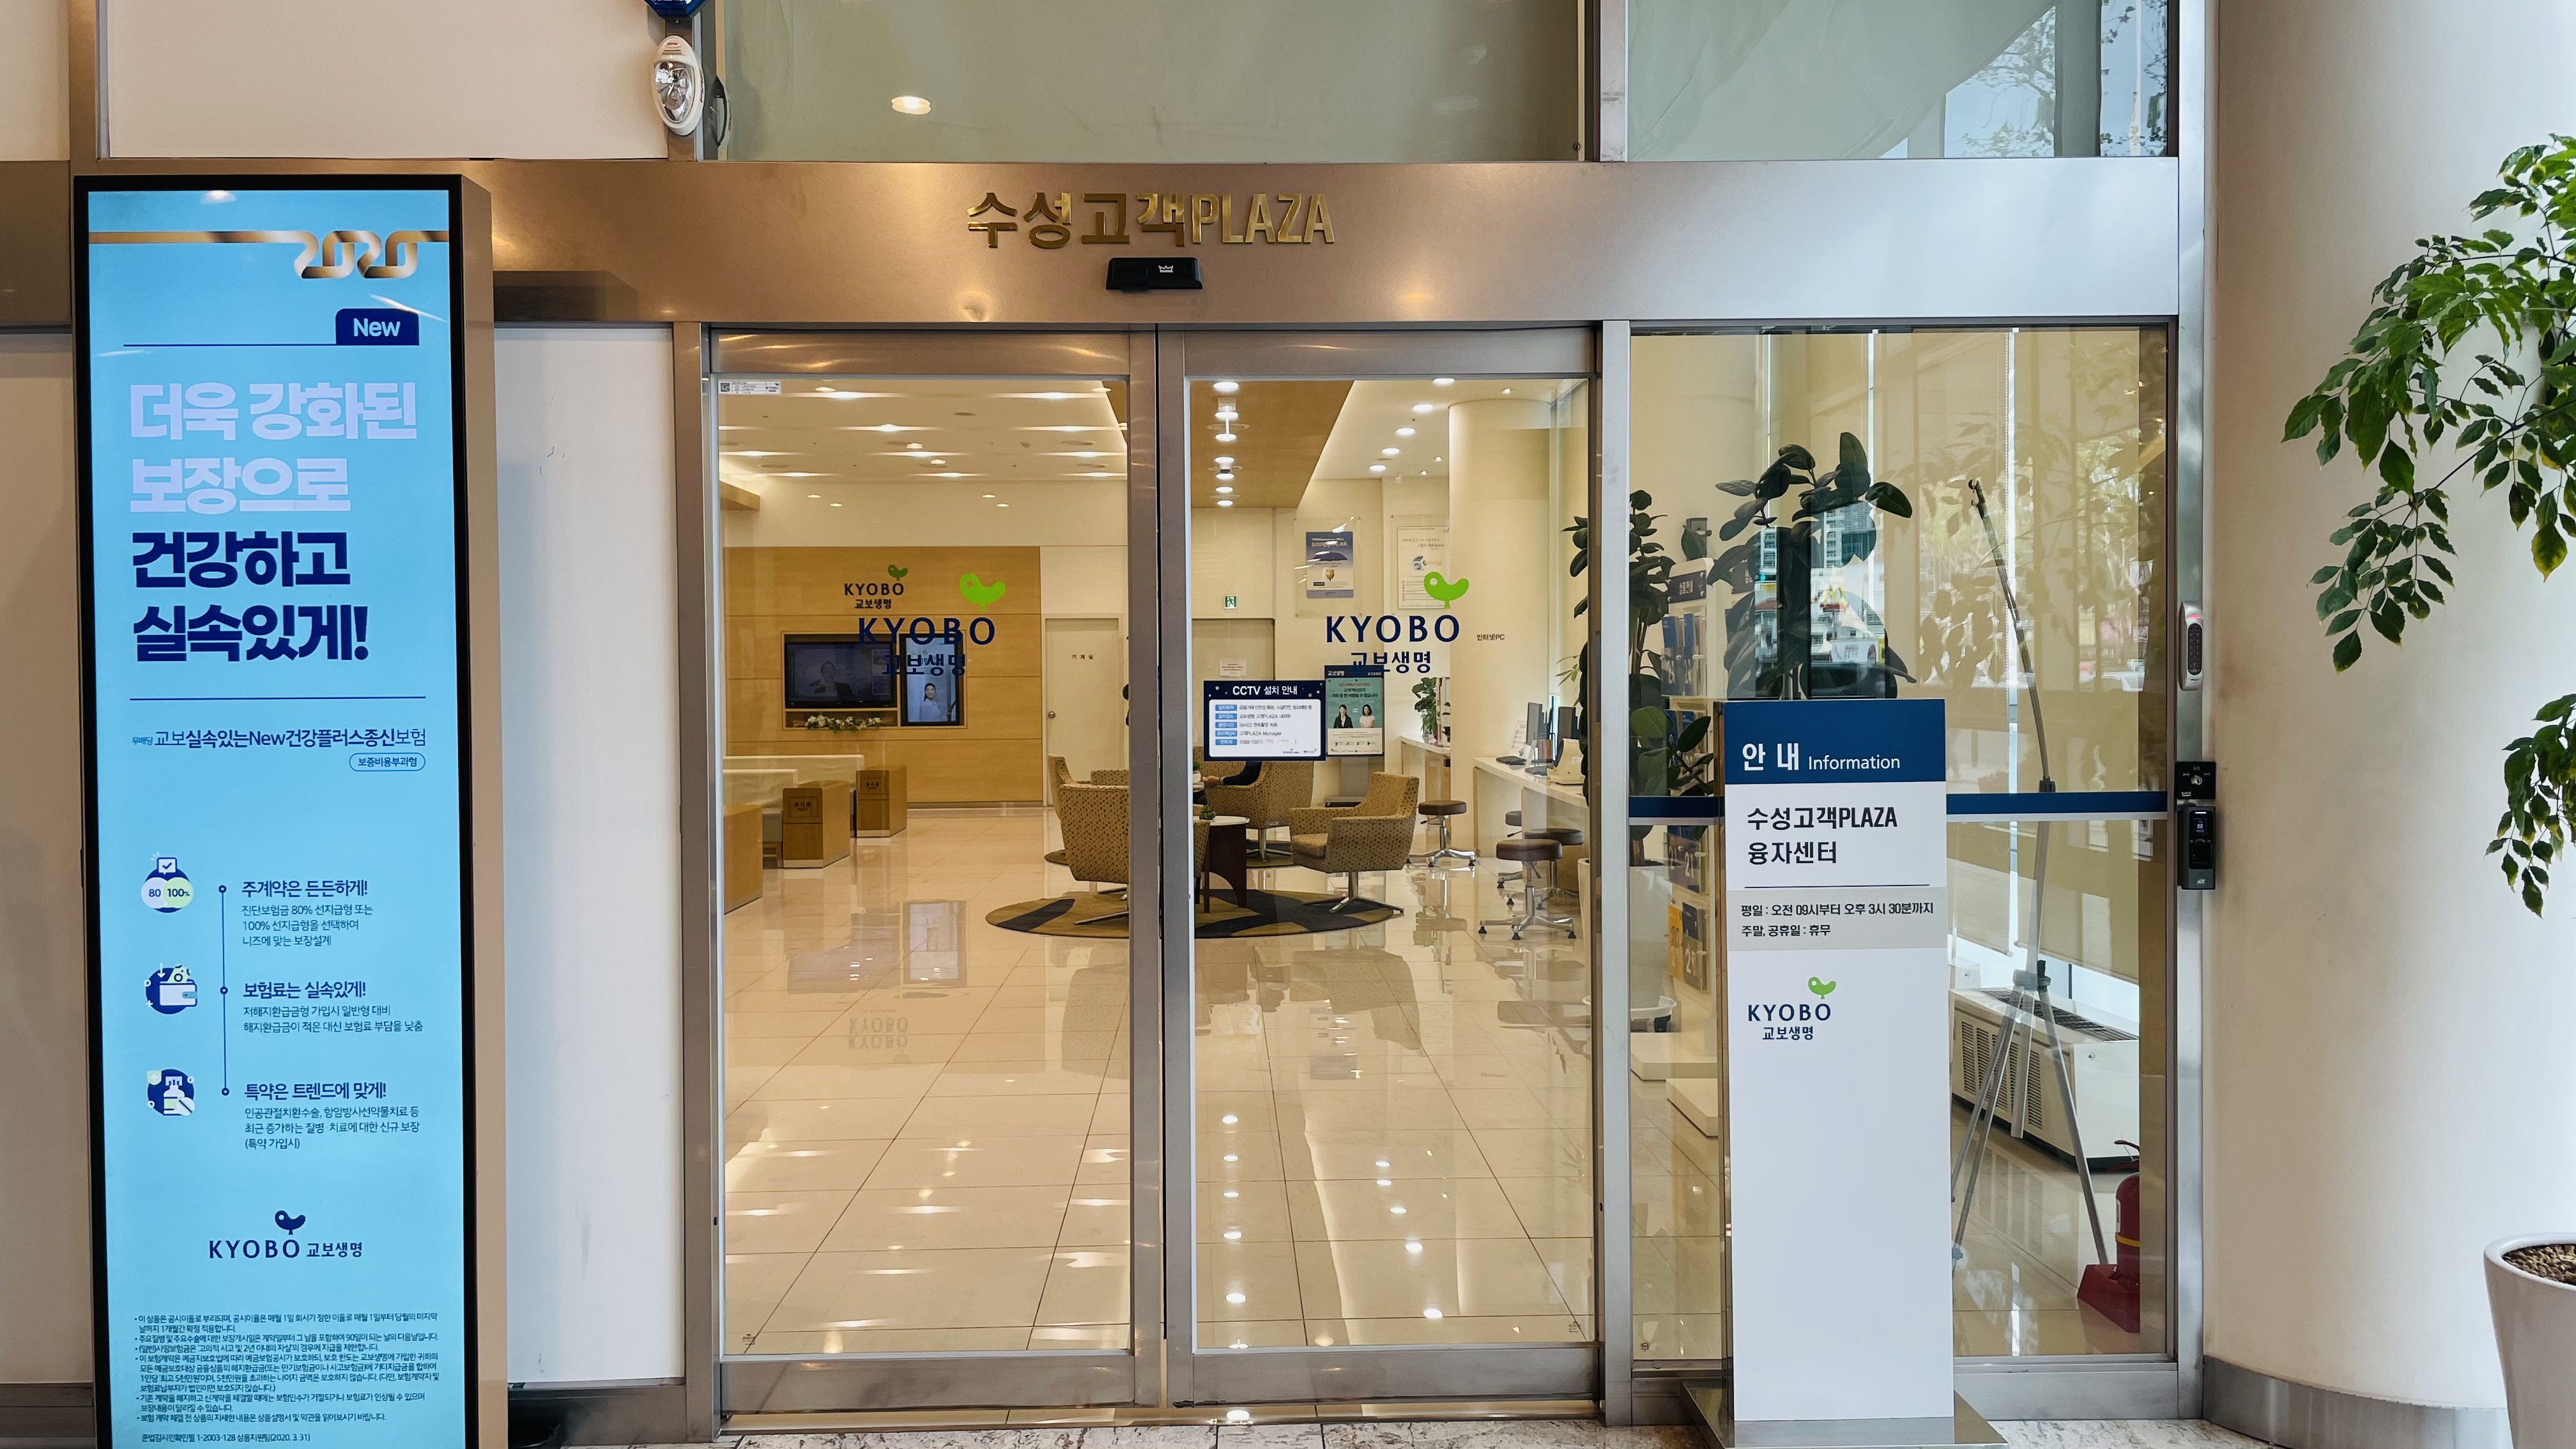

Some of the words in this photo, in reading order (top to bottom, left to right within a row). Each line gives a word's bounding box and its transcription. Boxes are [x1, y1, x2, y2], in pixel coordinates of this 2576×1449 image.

[966, 192, 1335, 248] 수성고객PLAZA
[353, 318, 401, 337] New
[130, 382, 239, 441] 더욱
[249, 381, 418, 441] 강화된
[130, 457, 351, 515] 보장으로
[132, 530, 351, 588] 건강하고
[844, 582, 904, 596] KYOBO
[854, 598, 892, 610] 교보생명
[133, 604, 369, 662] 실속있게!
[859, 617, 995, 645] KYOBO
[1326, 614, 1460, 643] KYOBO
[1476, 633, 1505, 641] 인터넷PC
[882, 653, 966, 677] 교보생명
[1232, 686, 1261, 696] CCTV
[1264, 686, 1279, 695] 설치
[1282, 686, 1298, 695] 안내
[357, 756, 417, 768] 보증비용부과형
[1809, 754, 1900, 770] Information
[1747, 806, 1898, 831] 수성고객PLAZA
[1748, 841, 1837, 865] 융자센터
[148, 889, 161, 898] 80
[241, 880, 303, 898] 주계약은
[305, 879, 368, 898] 든든하게!
[241, 905, 290, 917] 진단보험금
[291, 905, 313, 915] 80%
[314, 904, 353, 916] 선지급형
[354, 904, 374, 916] 또는
[1740, 905, 1763, 917] 평일
[1771, 904, 1793, 916] 오전
[1795, 903, 1841, 916] 09시부터
[1844, 903, 1866, 916] 오후
[1868, 903, 1886, 915] 3시
[1888, 901, 1933, 915] 30분까지
[242, 921, 270, 931] 100%
[272, 919, 319, 931] 선지급형을
[321, 919, 359, 931] 선택하여
[1741, 925, 1766, 937] 주말,
[1768, 924, 1800, 937] 공휴일
[1809, 924, 1831, 937] 휴무
[242, 935, 271, 947] 니즈에
[273, 935, 292, 947] 맞는
[293, 935, 332, 947] 보장설계
[243, 981, 302, 999] 보험료는
[304, 980, 366, 999] 실속있게!
[243, 1006, 309, 1018] 저해지환급금형
[311, 1005, 340, 1017] 가입시
[341, 1005, 370, 1017] 일반형
[372, 1004, 391, 1016] 대비
[1748, 1003, 1831, 1022] KYOBO
[243, 1022, 300, 1034] 해지환급금이
[302, 1022, 321, 1033] 적은
[323, 1021, 342, 1032] 대신
[343, 1021, 372, 1032] 보험료
[374, 1020, 403, 1032] 부담을
[404, 1020, 424, 1032] 낮춤
[1762, 1025, 1813, 1041] 교보생명
[244, 1083, 289, 1101] 특약은
[291, 1082, 349, 1100] 트렌드에
[353, 1082, 387, 1100] 맞게!
[245, 1107, 322, 1119] 인공관절치환수술,
[323, 1106, 409, 1119] 항암방사선약물치료
[410, 1106, 420, 1118] 등
[245, 1123, 264, 1134] 최근
[266, 1123, 303, 1134] 증가하는
[360, 1122, 378, 1133] 대한
[380, 1122, 399, 1132] 신규
[401, 1122, 420, 1133] 보장
[245, 1138, 267, 1150] (특약
[268, 1138, 300, 1149] 가입시)
[209, 1239, 300, 1259] KYOBO
[306, 1241, 362, 1258] 교보생명
